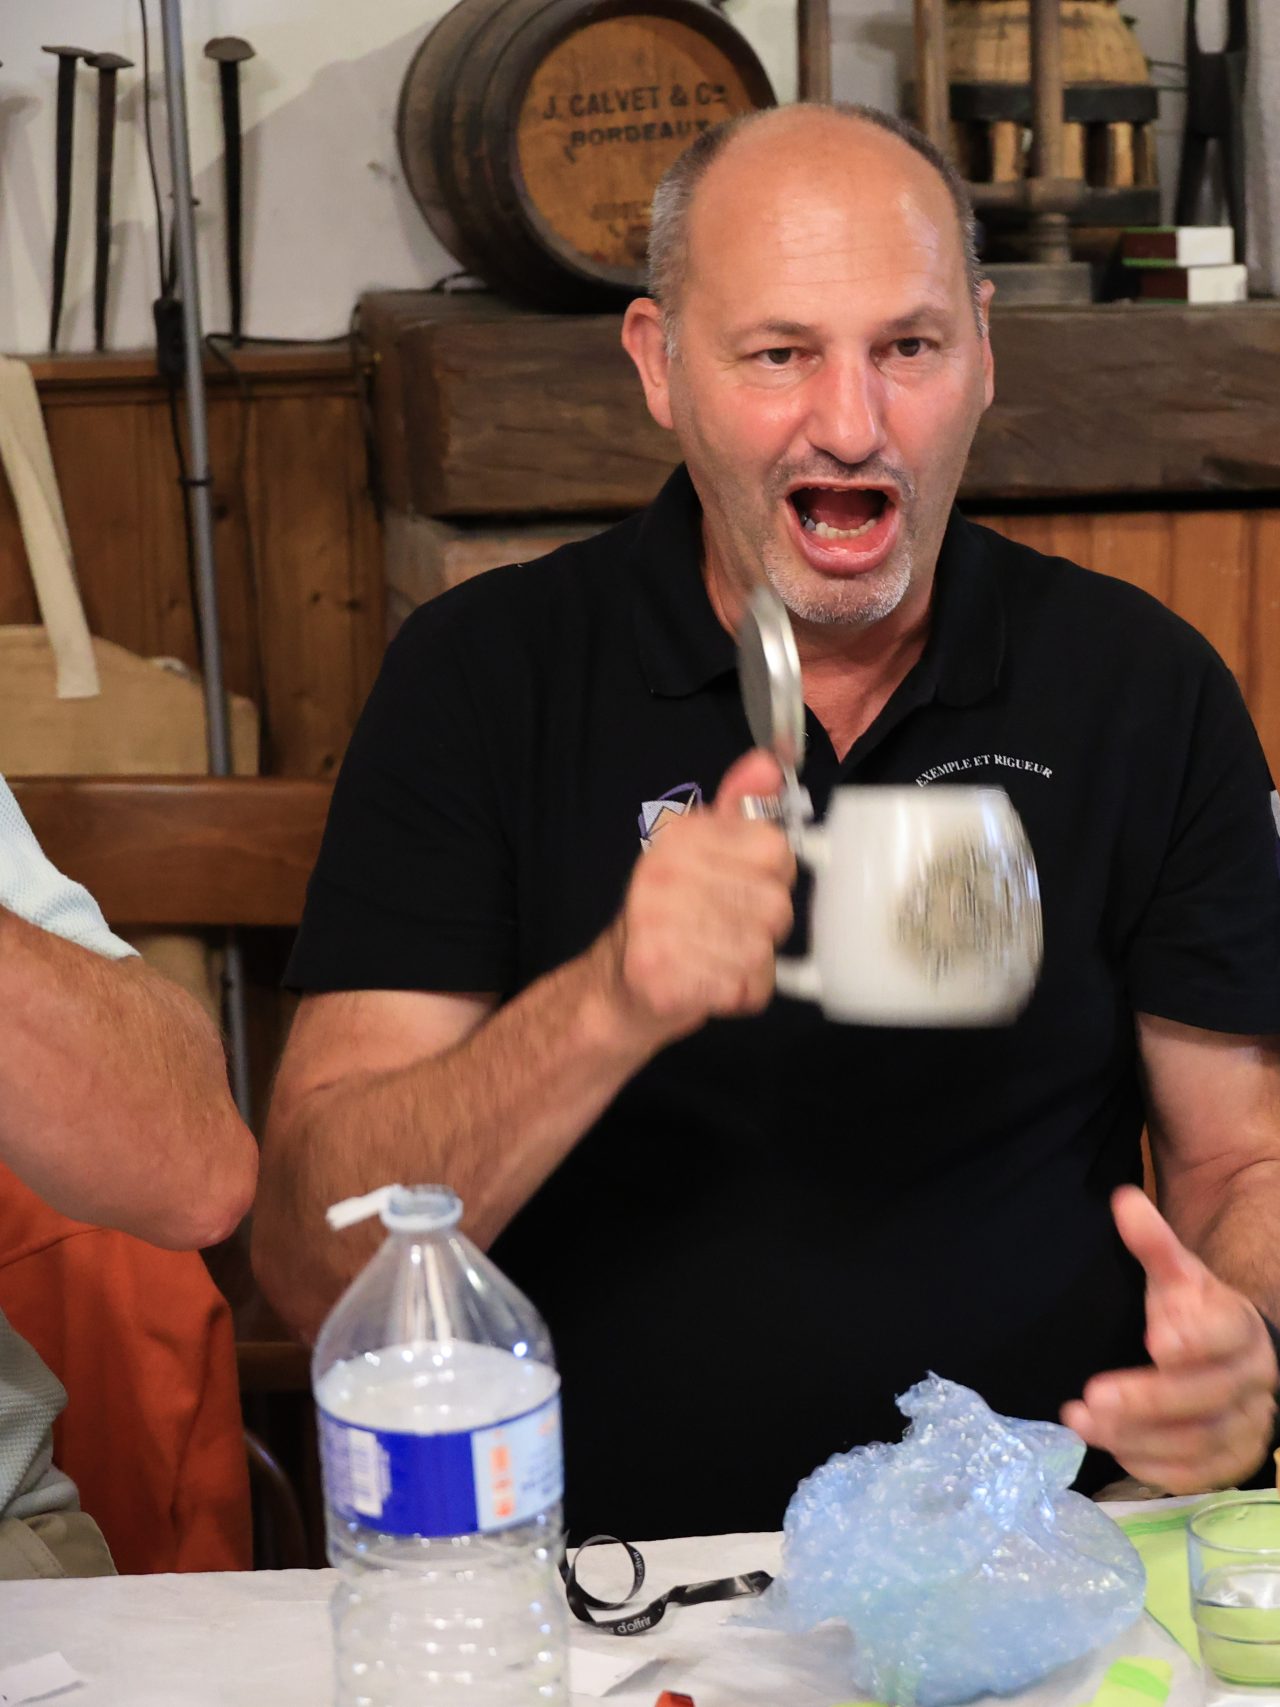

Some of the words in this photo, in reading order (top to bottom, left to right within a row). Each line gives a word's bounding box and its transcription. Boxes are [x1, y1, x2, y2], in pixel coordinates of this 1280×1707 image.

[569, 86, 661, 117] CALVET
[670, 83, 688, 107] &
[915, 758, 972, 788] EXEMPLE
[973, 754, 991, 767] ET
[994, 753, 1053, 779] RIGUEUR
